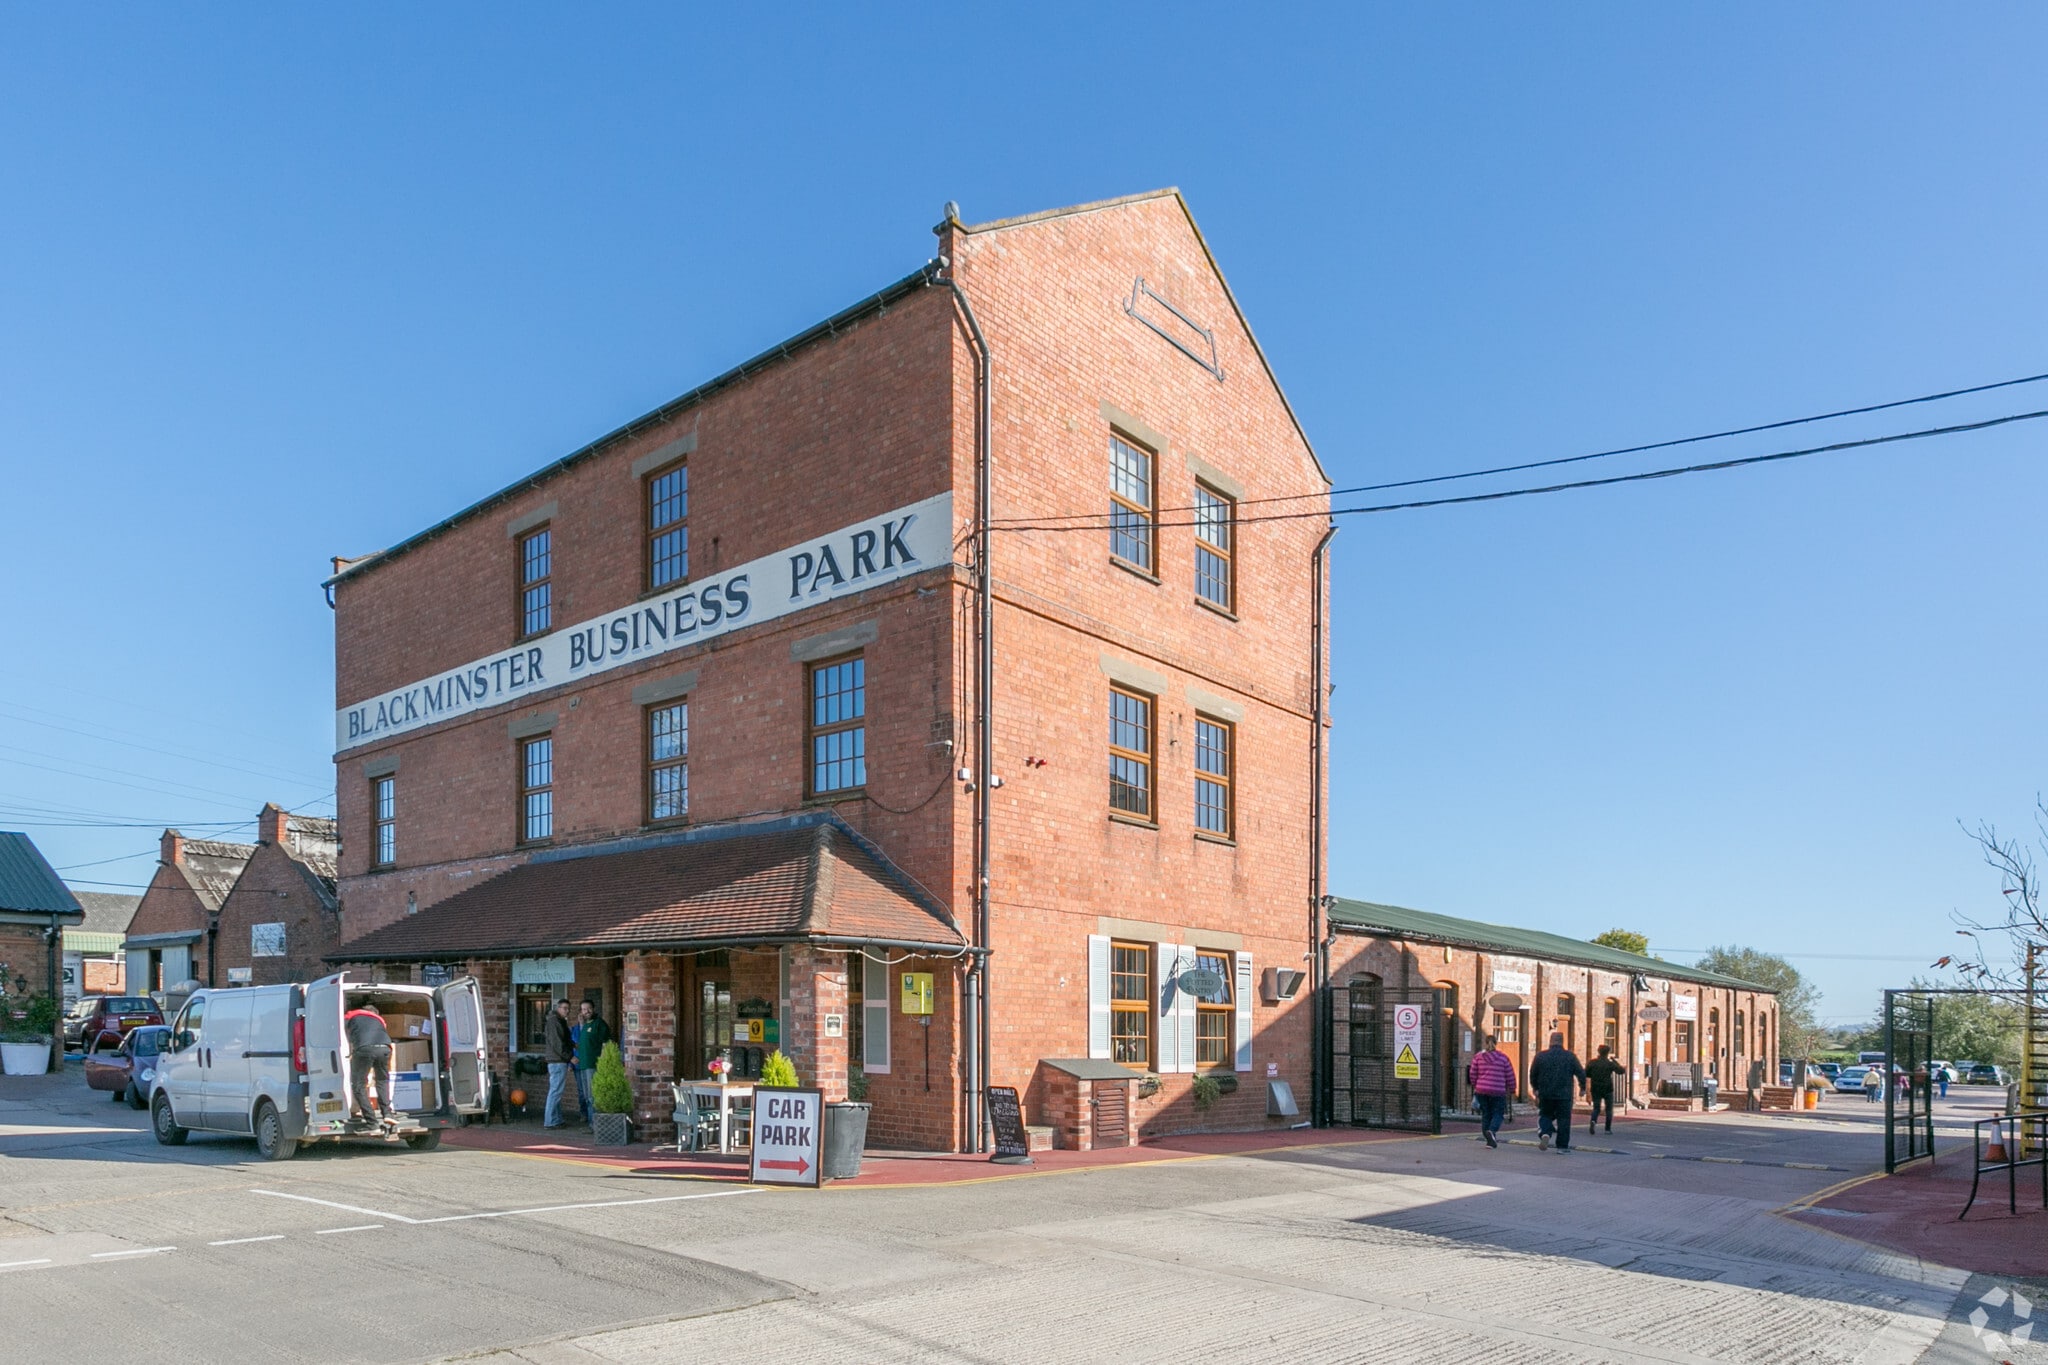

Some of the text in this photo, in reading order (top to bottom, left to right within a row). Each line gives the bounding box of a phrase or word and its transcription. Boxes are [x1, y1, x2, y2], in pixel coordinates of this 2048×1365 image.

[347, 514, 918, 740] BLACKMINSTER BUSINESS PARK
[1186, 978, 1214, 986] POTTED
[1405, 1012, 1411, 1020] 5
[768, 1098, 805, 1120] CAR
[761, 1124, 811, 1146] PARK
